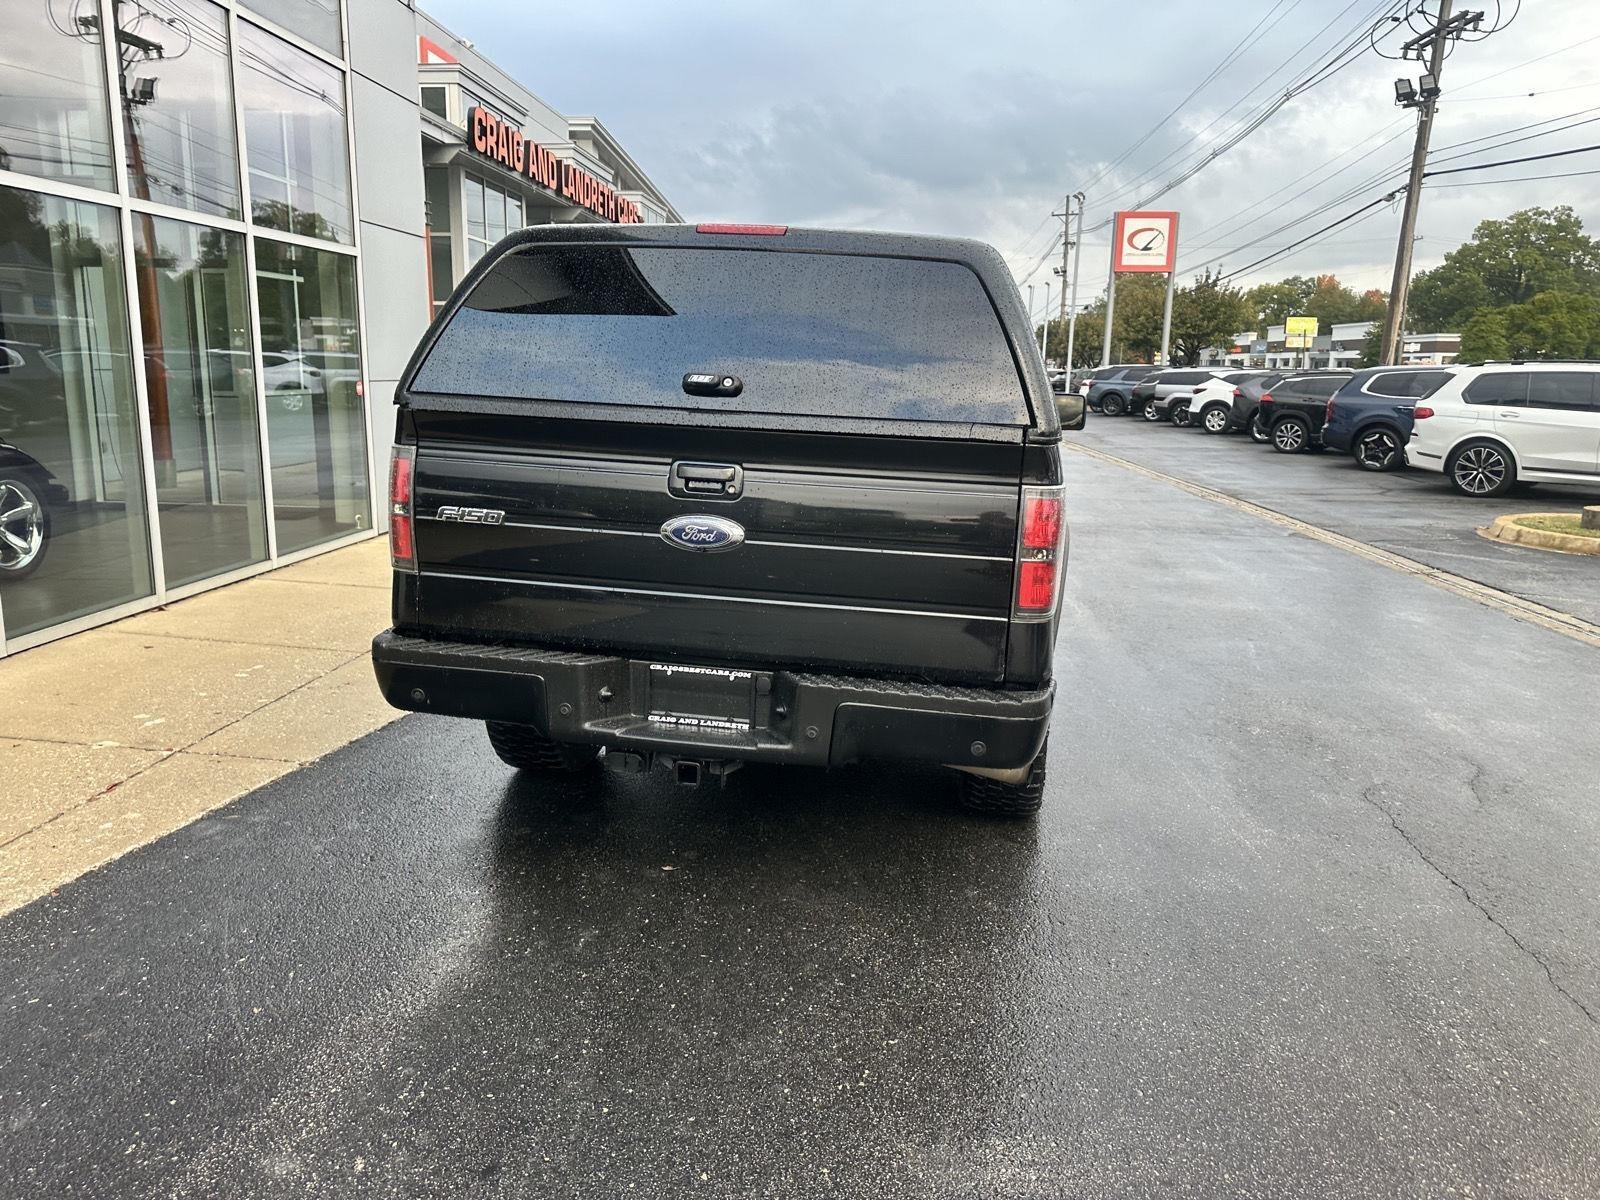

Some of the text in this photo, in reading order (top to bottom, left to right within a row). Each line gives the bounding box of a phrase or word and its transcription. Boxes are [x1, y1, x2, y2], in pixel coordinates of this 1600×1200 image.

[473, 106, 524, 173] CRAIG
[529, 140, 557, 190] AND
[561, 159, 615, 221] LANDRETH
[681, 525, 717, 541] Ford
[648, 715, 677, 723] CRAIG
[700, 720, 750, 730] LANDRETH
